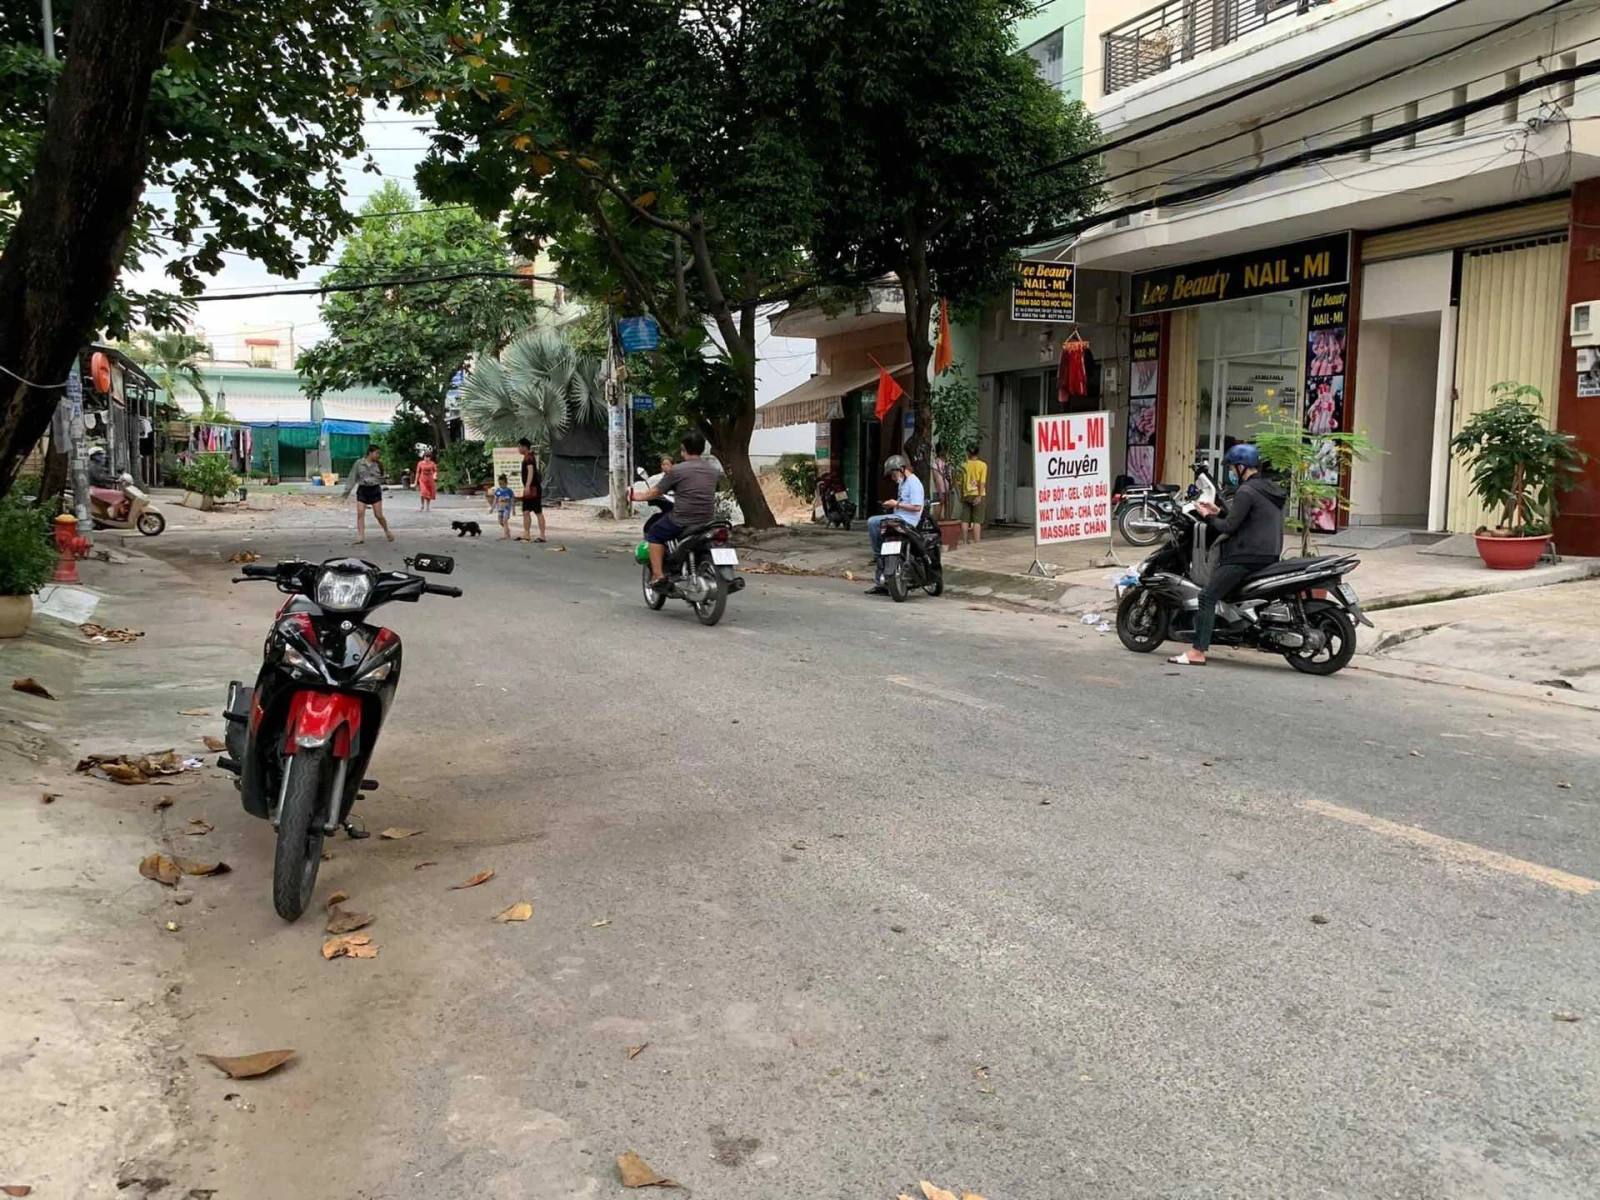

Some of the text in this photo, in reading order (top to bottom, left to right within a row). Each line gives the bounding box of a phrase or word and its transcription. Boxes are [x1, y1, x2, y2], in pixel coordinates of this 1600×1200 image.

[1036, 264, 1073, 281] Beauty
[1142, 279, 1168, 305] Lee
[1173, 269, 1230, 300] Beauty
[1244, 259, 1289, 289] NAIL
[1303, 251, 1330, 279] MI
[1311, 292, 1347, 308] Lee Beauty
[1038, 420, 1075, 452] NAIL
[1087, 417, 1104, 449] MI
[1048, 454, 1098, 478] Chuyên
[1040, 518, 1107, 540] MASSAGE CHÂN
